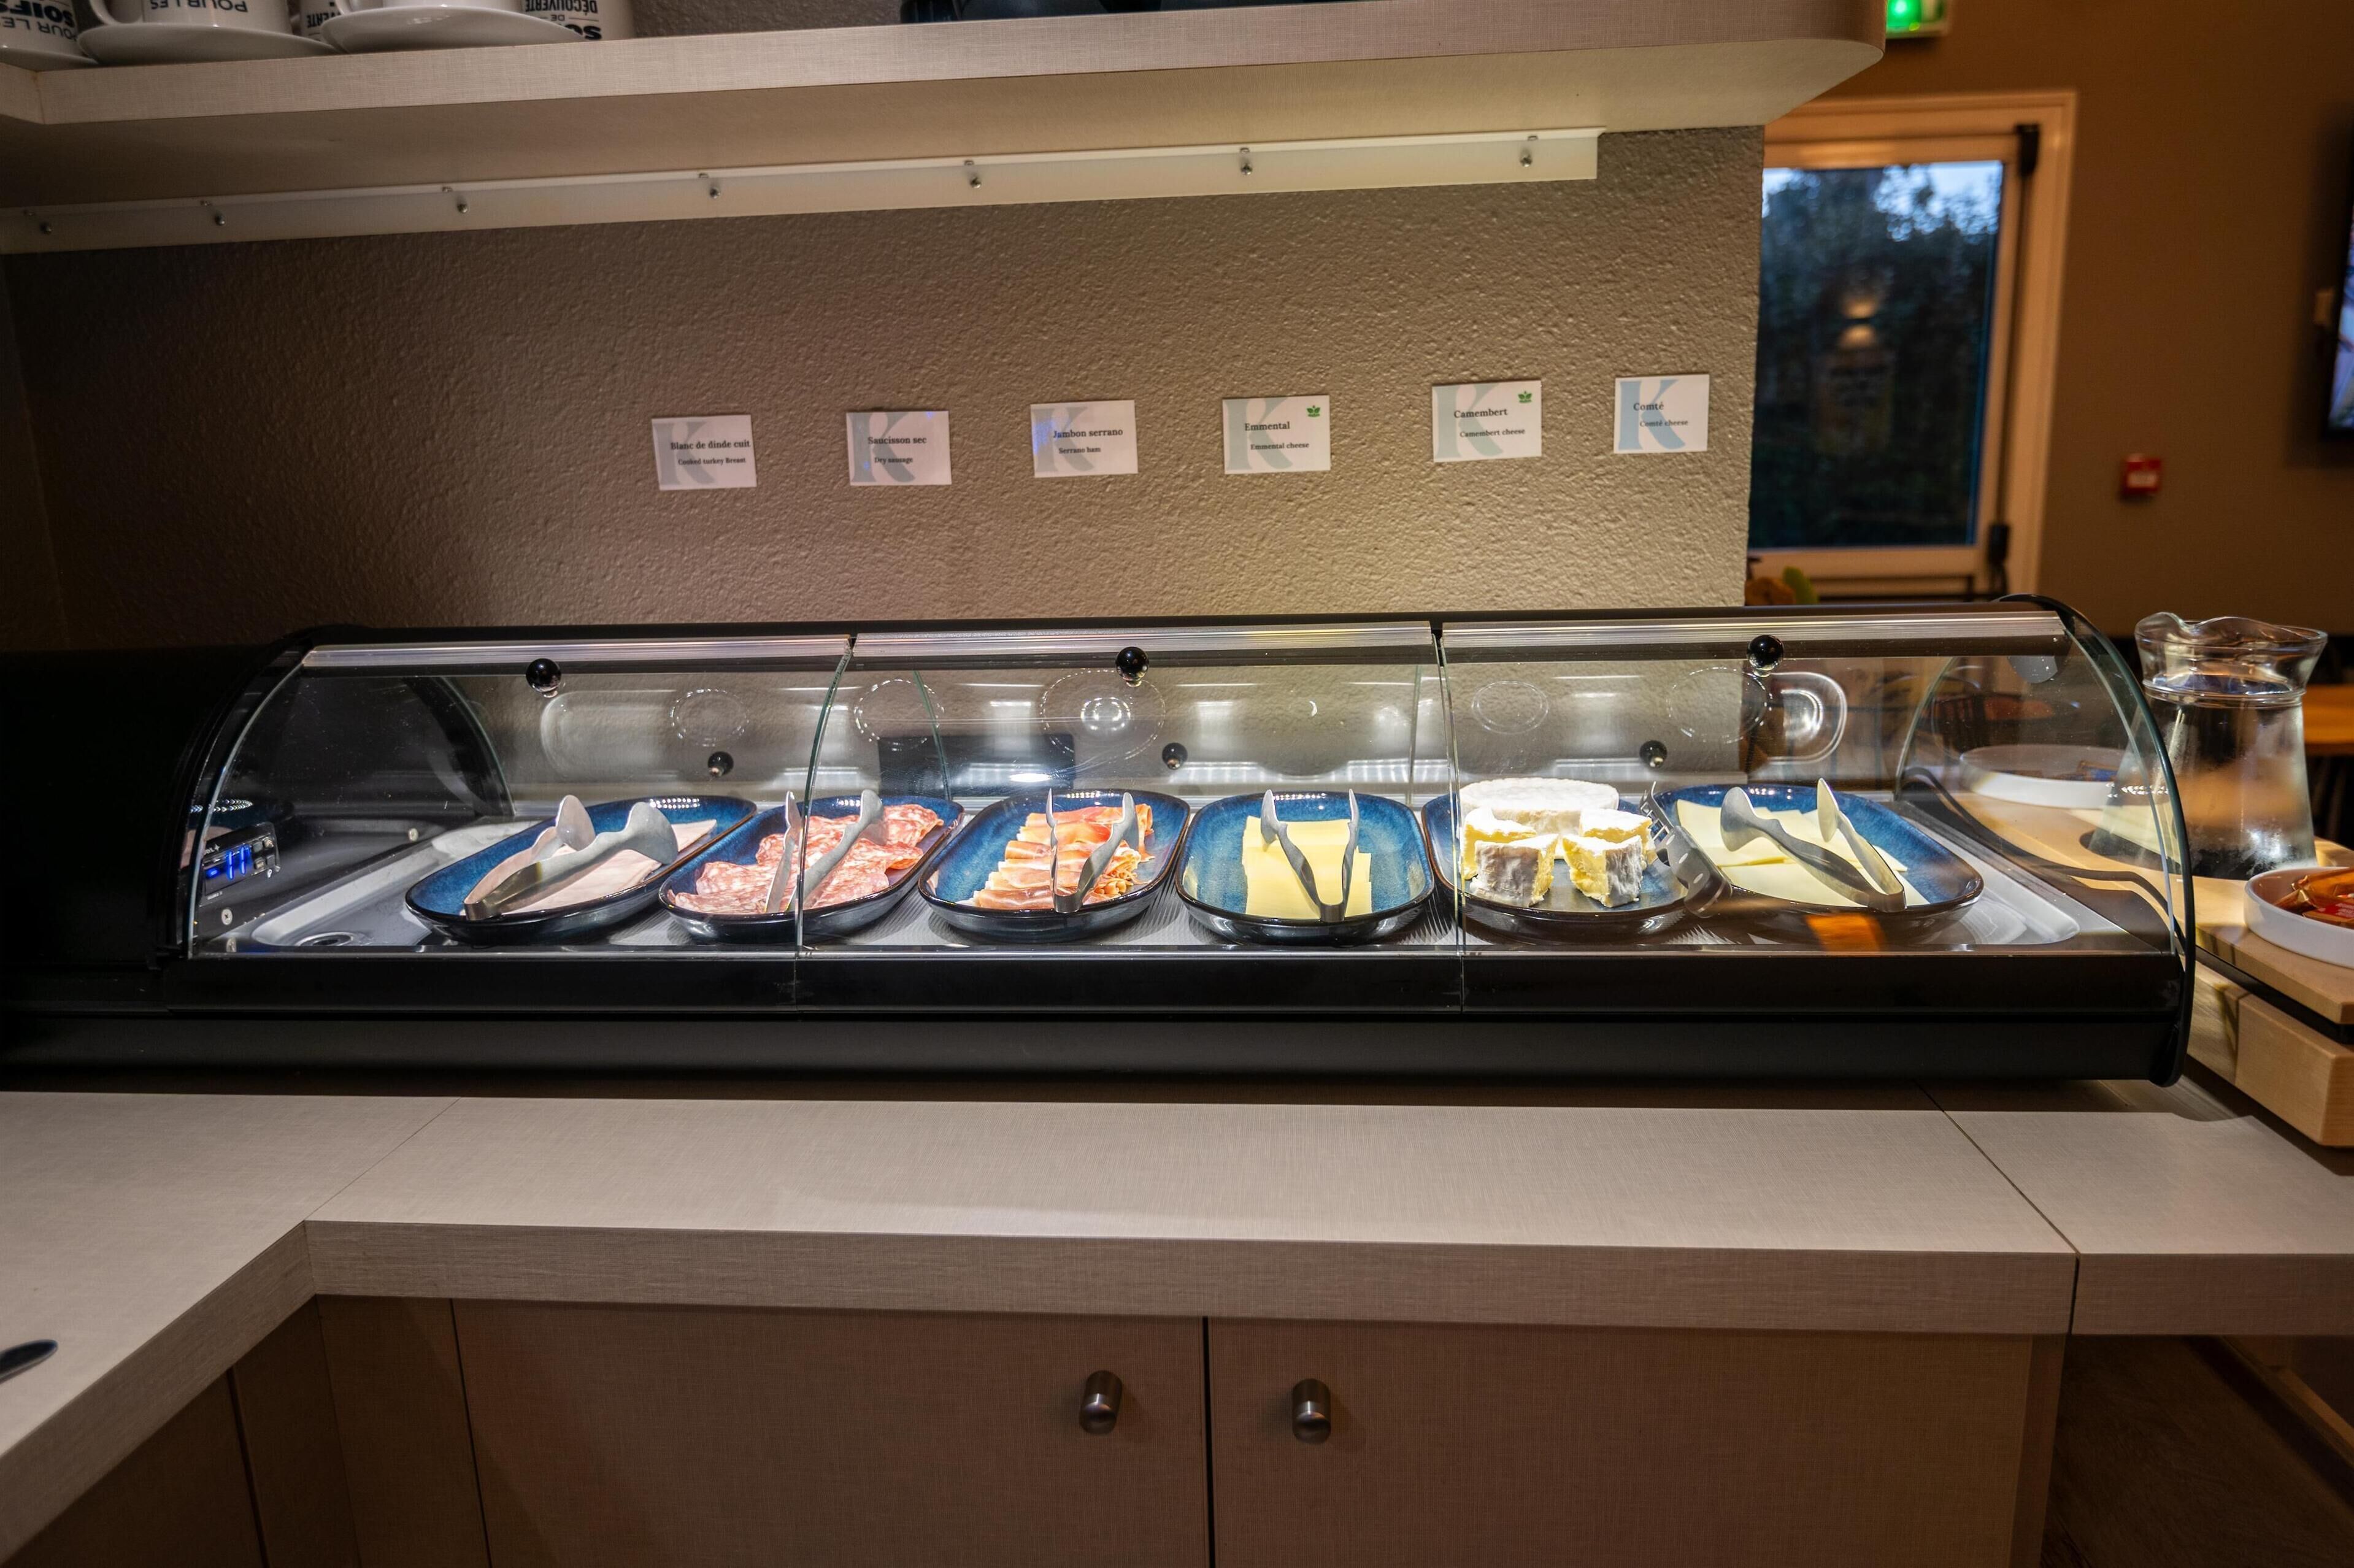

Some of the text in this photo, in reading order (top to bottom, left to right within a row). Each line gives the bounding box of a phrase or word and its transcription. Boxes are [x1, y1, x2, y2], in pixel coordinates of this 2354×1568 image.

[0, 17, 30, 29] LE
[1633, 401, 1664, 411] Comté
[1453, 408, 1508, 418] Camembert
[1244, 421, 1290, 431] Emmental
[1053, 429, 1087, 438] Jambon
[671, 442, 694, 450] Blanc
[708, 440, 731, 448] dinde
[867, 436, 910, 445] Saucisson
